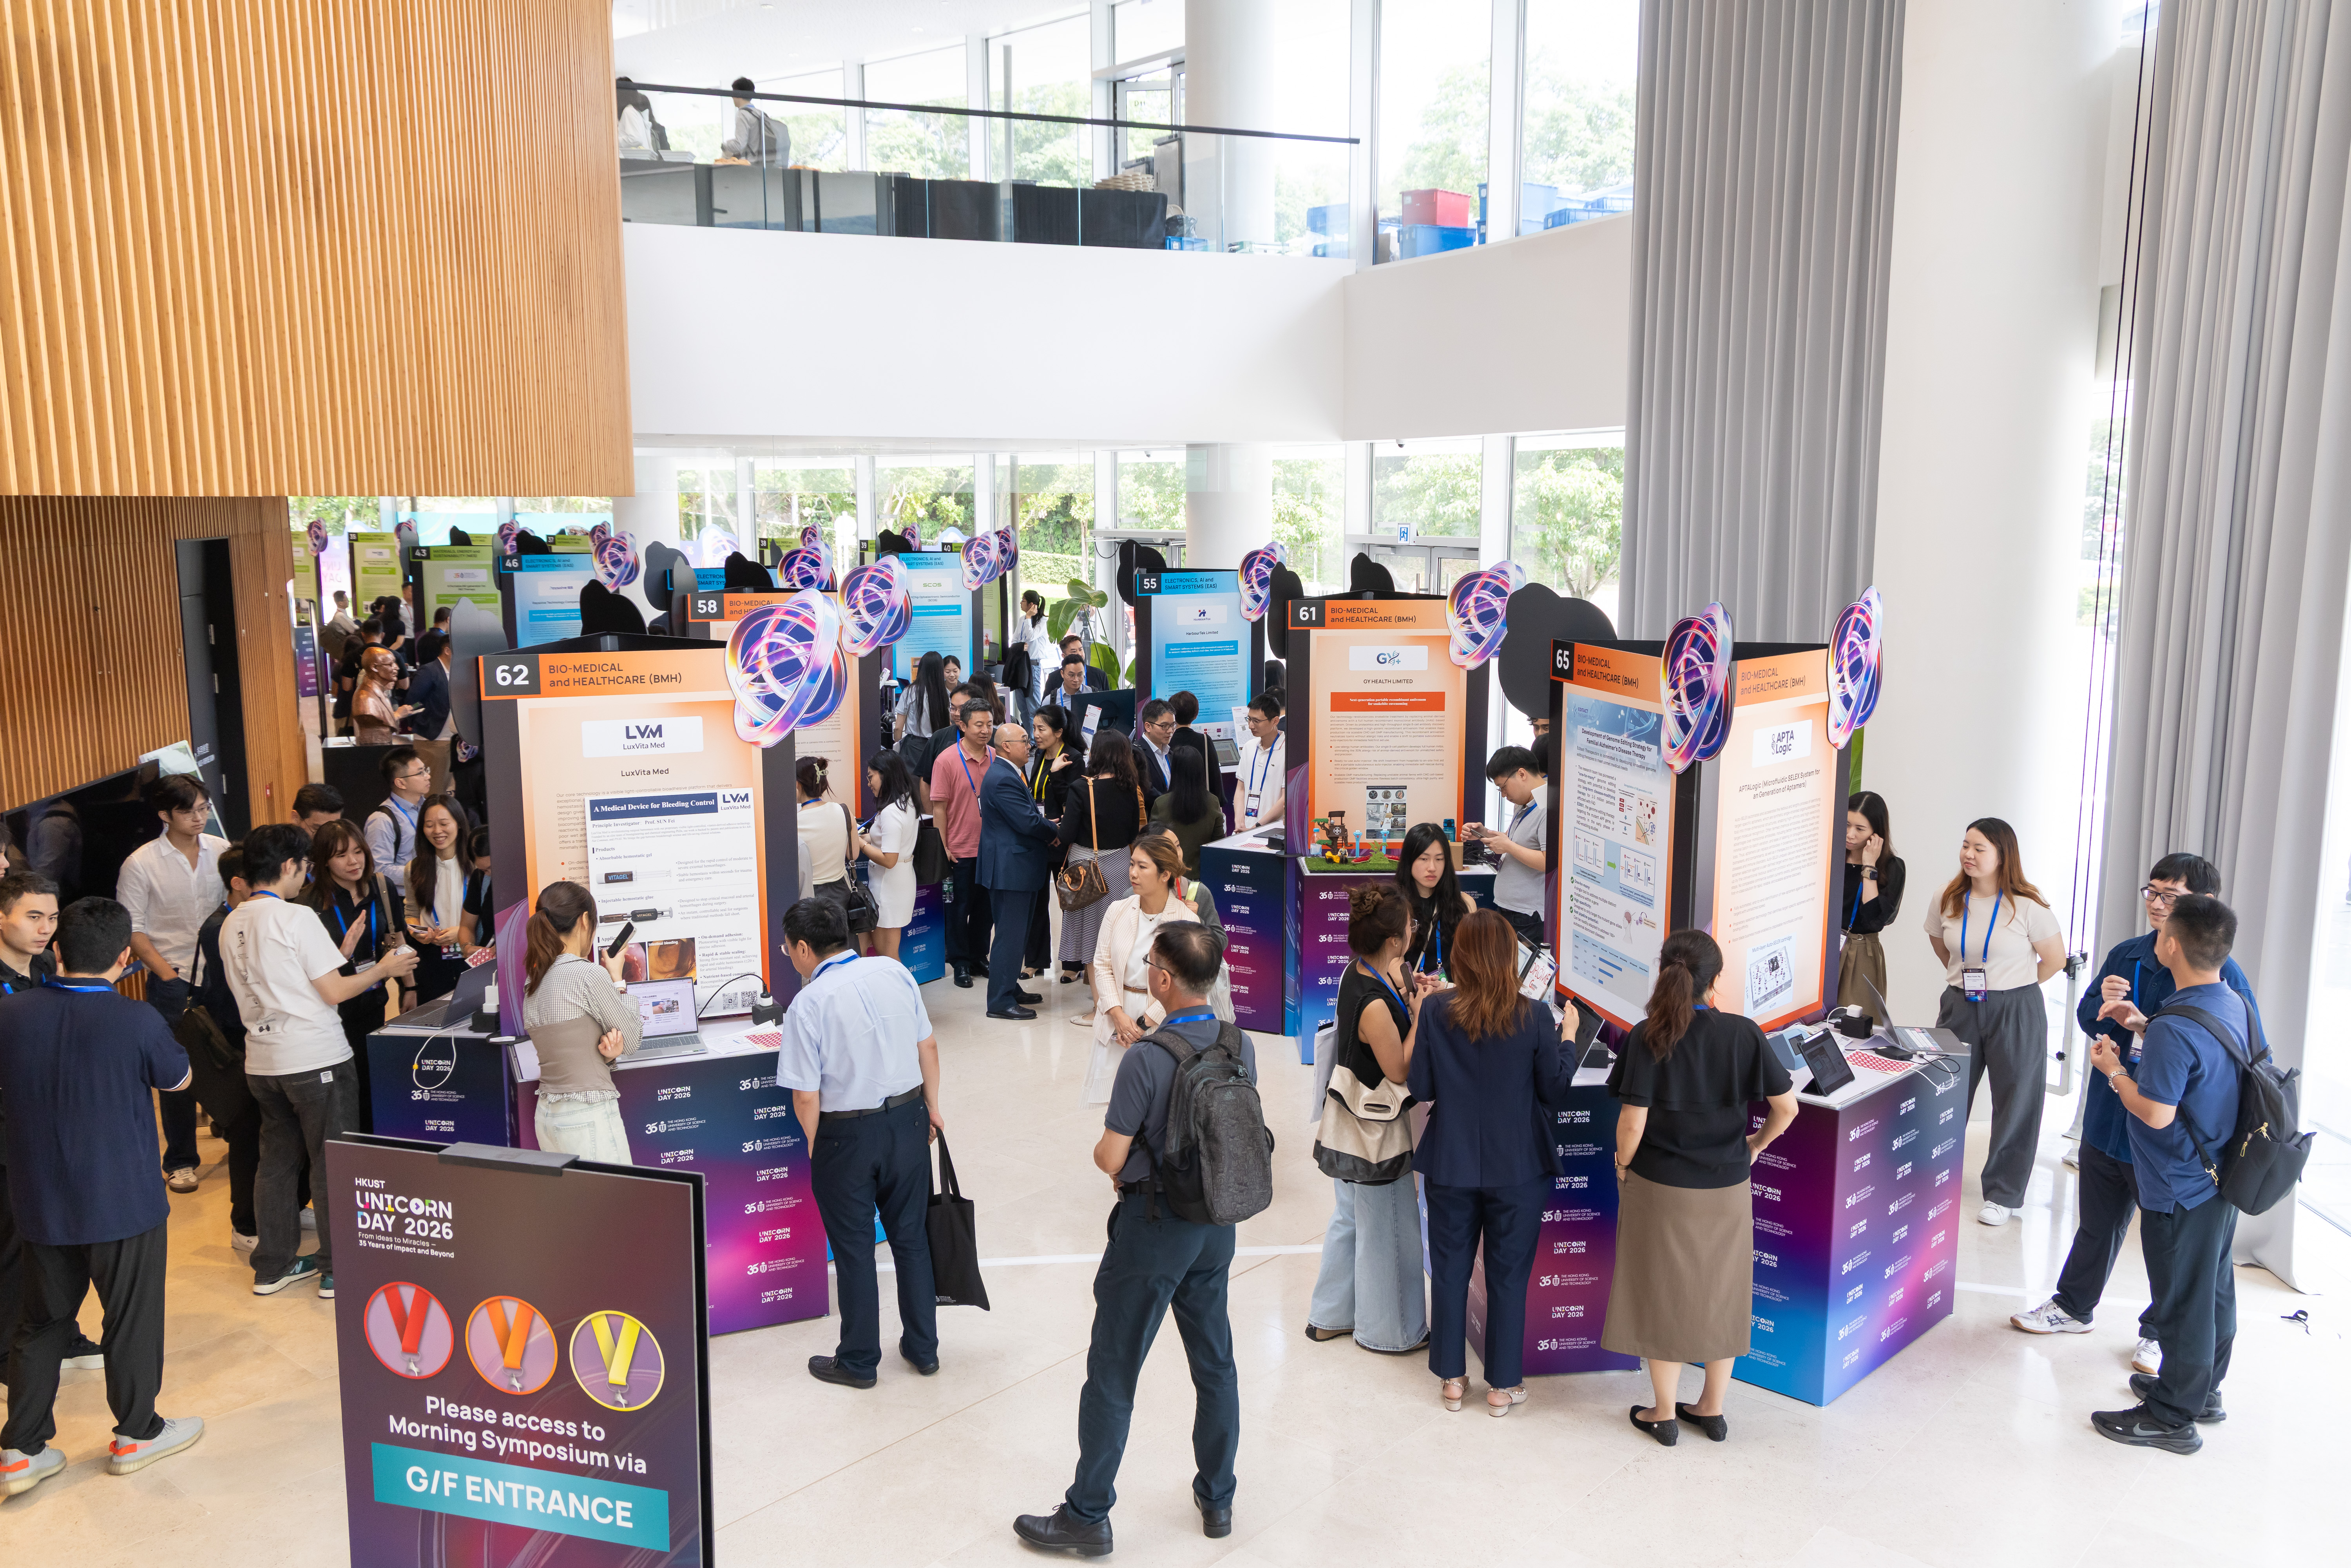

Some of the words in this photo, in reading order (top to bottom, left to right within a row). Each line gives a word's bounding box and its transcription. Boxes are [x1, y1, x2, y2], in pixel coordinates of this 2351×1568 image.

[1144, 578, 1156, 589] 55
[697, 600, 717, 613] 58
[1299, 607, 1316, 621] 61
[1556, 649, 1569, 669] 65
[1578, 654, 1610, 668] BIO-MEDICAL
[495, 664, 529, 686] 62
[549, 663, 623, 674] BIO-MEDICAL
[1742, 668, 1778, 681] BIO-MEDICAL
[549, 677, 570, 687] and
[573, 675, 645, 686] HEALTHCARE
[649, 672, 682, 685] (BMH)
[1587, 669, 1620, 684] HEALTHCARE
[1622, 675, 1639, 689] (BMH)
[1741, 685, 1751, 695] and
[1753, 679, 1788, 693] HEALTHCARE
[1790, 675, 1805, 688] (BMH)
[626, 724, 663, 739] LVM
[1777, 730, 1794, 743] APTA
[1582, 728, 1602, 739] Development
[1607, 735, 1620, 744] Genome
[1621, 739, 1632, 748] Editing
[1632, 742, 1646, 751] Strategy
[1632, 751, 1646, 760] Therapy
[1776, 743, 1791, 755] Logic
[1739, 782, 1761, 793] APTALogic
[1762, 776, 1787, 789] (Microfluidic
[1800, 770, 1814, 779] System
[1759, 786, 1782, 798] Generation
[1787, 780, 1806, 792] Aptamers)
[723, 793, 749, 803] LVM
[658, 1086, 690, 1095] UNICORN
[646, 1122, 657, 1134] 35
[1855, 1153, 1870, 1165] UNICORN
[355, 1177, 385, 1189] HKUST
[356, 1191, 452, 1219] UNICORN
[357, 1211, 396, 1232] DAY
[404, 1218, 453, 1240] 2026
[403, 1238, 429, 1247] Miracles
[394, 1244, 416, 1253] Impact
[431, 1249, 454, 1258] Beyond
[426, 1396, 497, 1423] Please
[502, 1412, 577, 1437] access
[581, 1421, 605, 1441] to
[389, 1415, 476, 1451] Morning
[482, 1430, 609, 1467] Symposium
[614, 1453, 646, 1474] via
[406, 1466, 458, 1497] G/F
[466, 1475, 633, 1528] ENTRANCE
